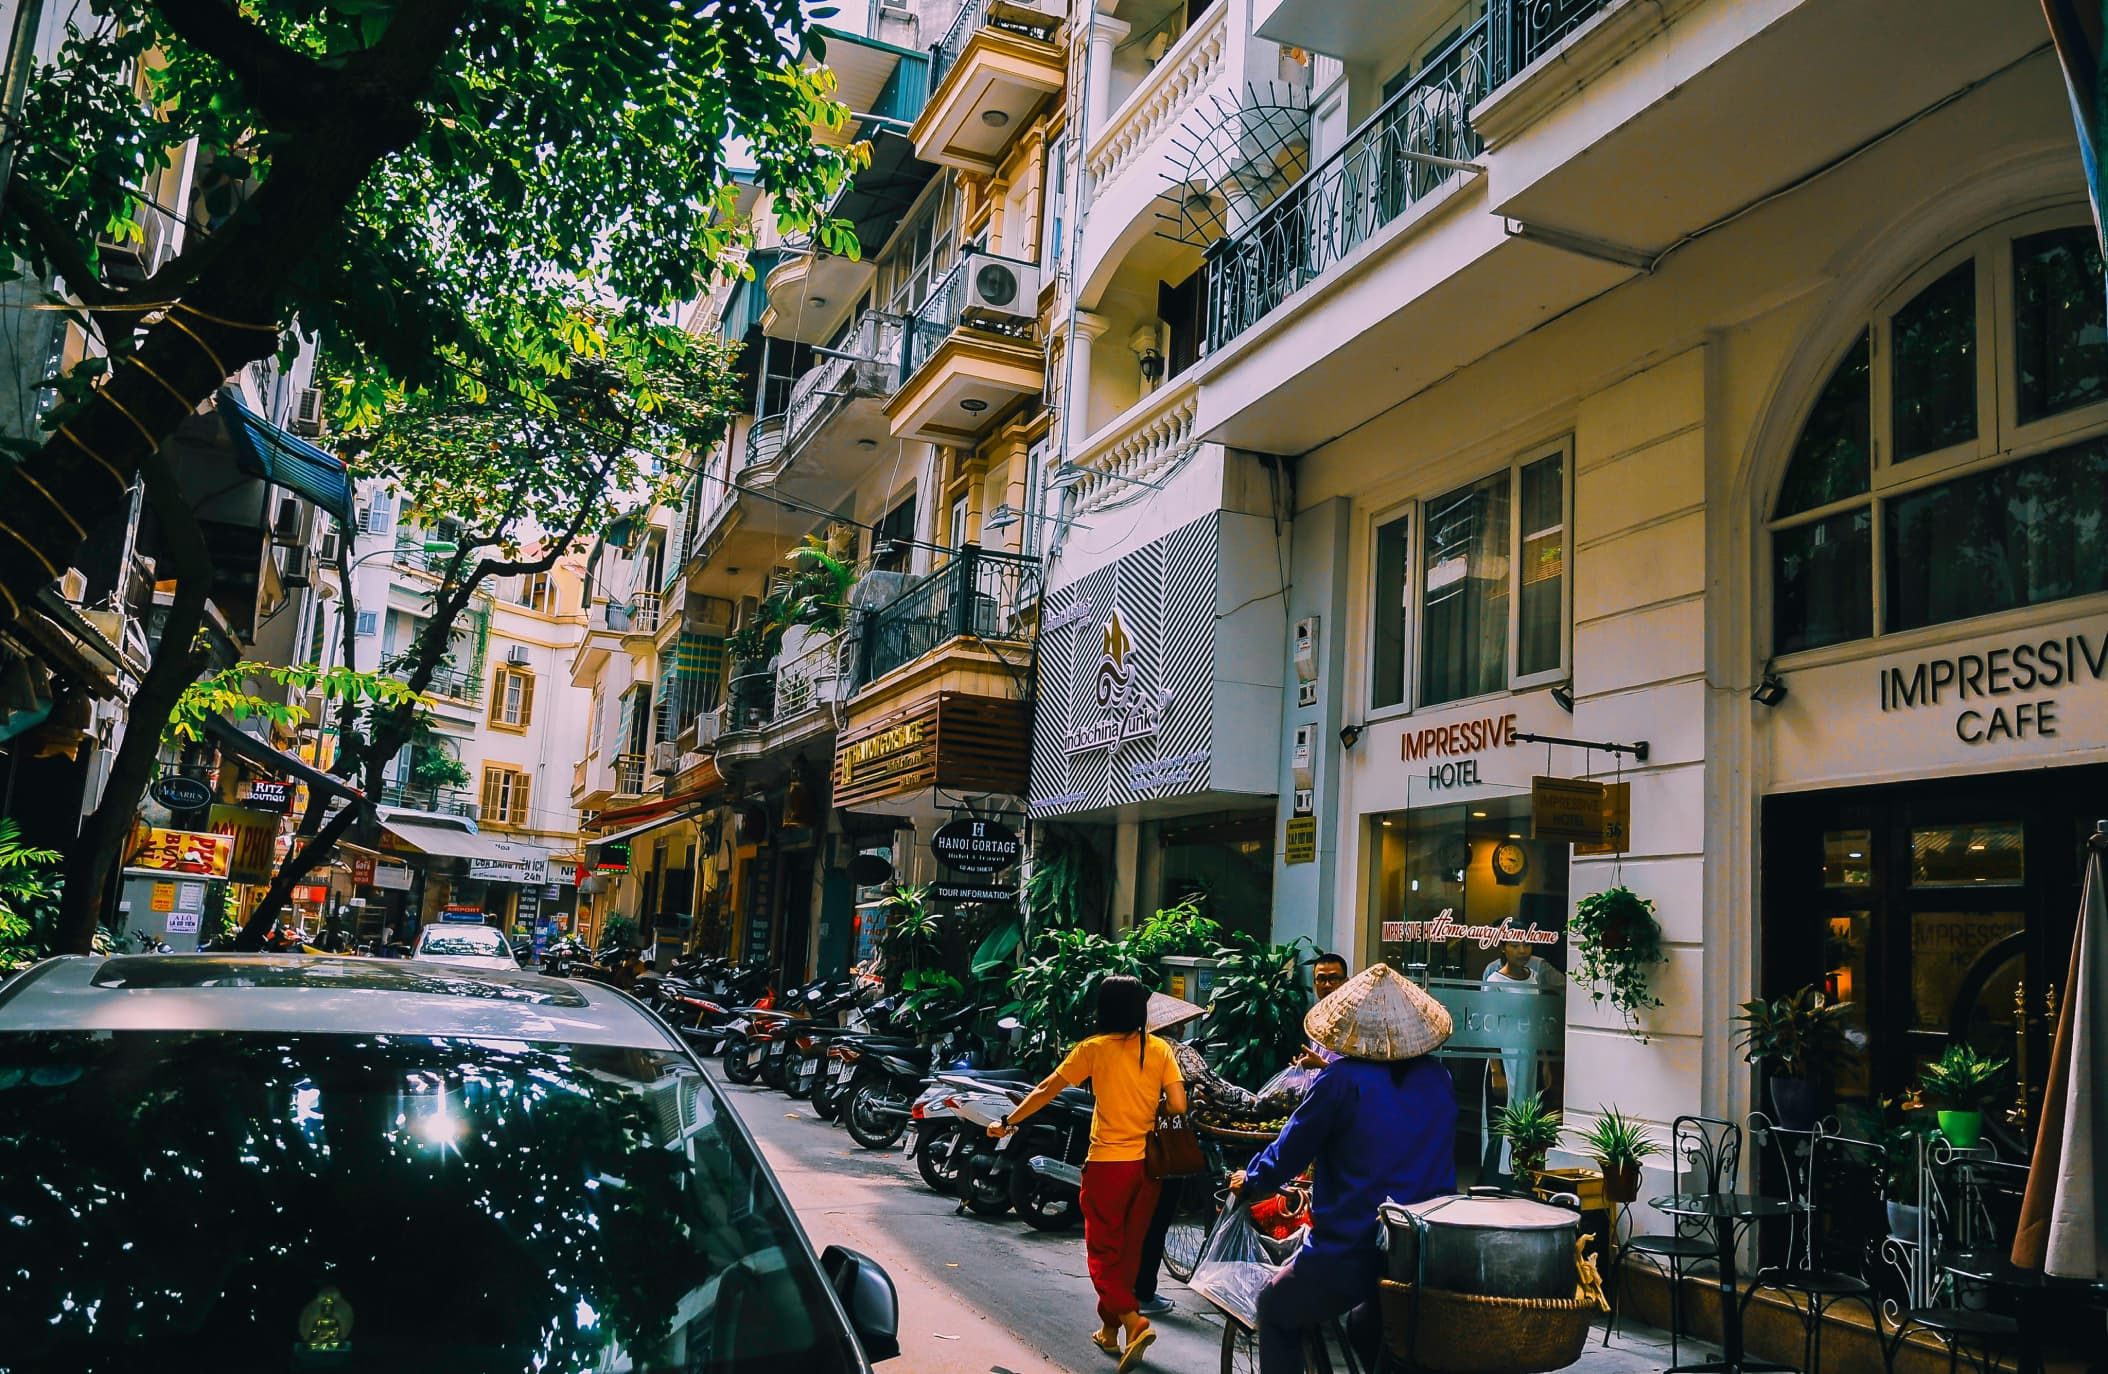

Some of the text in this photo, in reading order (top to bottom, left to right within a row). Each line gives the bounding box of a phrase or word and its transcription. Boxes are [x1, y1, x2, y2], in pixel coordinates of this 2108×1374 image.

[1064, 720, 1119, 750] indochina
[1956, 700, 2059, 745] CAFE
[1401, 713, 1517, 762] IMPRESSIVE
[1428, 759, 1482, 791] HOTEL
[255, 782, 284, 794] RITZ
[938, 836, 1016, 854] HANOI GORTAGE
[524, 872, 541, 882] 24h
[939, 888, 1010, 900] TOUR INFORMATION
[1382, 922, 1422, 943] IMPRESSIVE
[1432, 908, 1468, 938] Home
[1467, 924, 1496, 950] away
[1493, 917, 1525, 947] from
[1525, 922, 1559, 944] home
